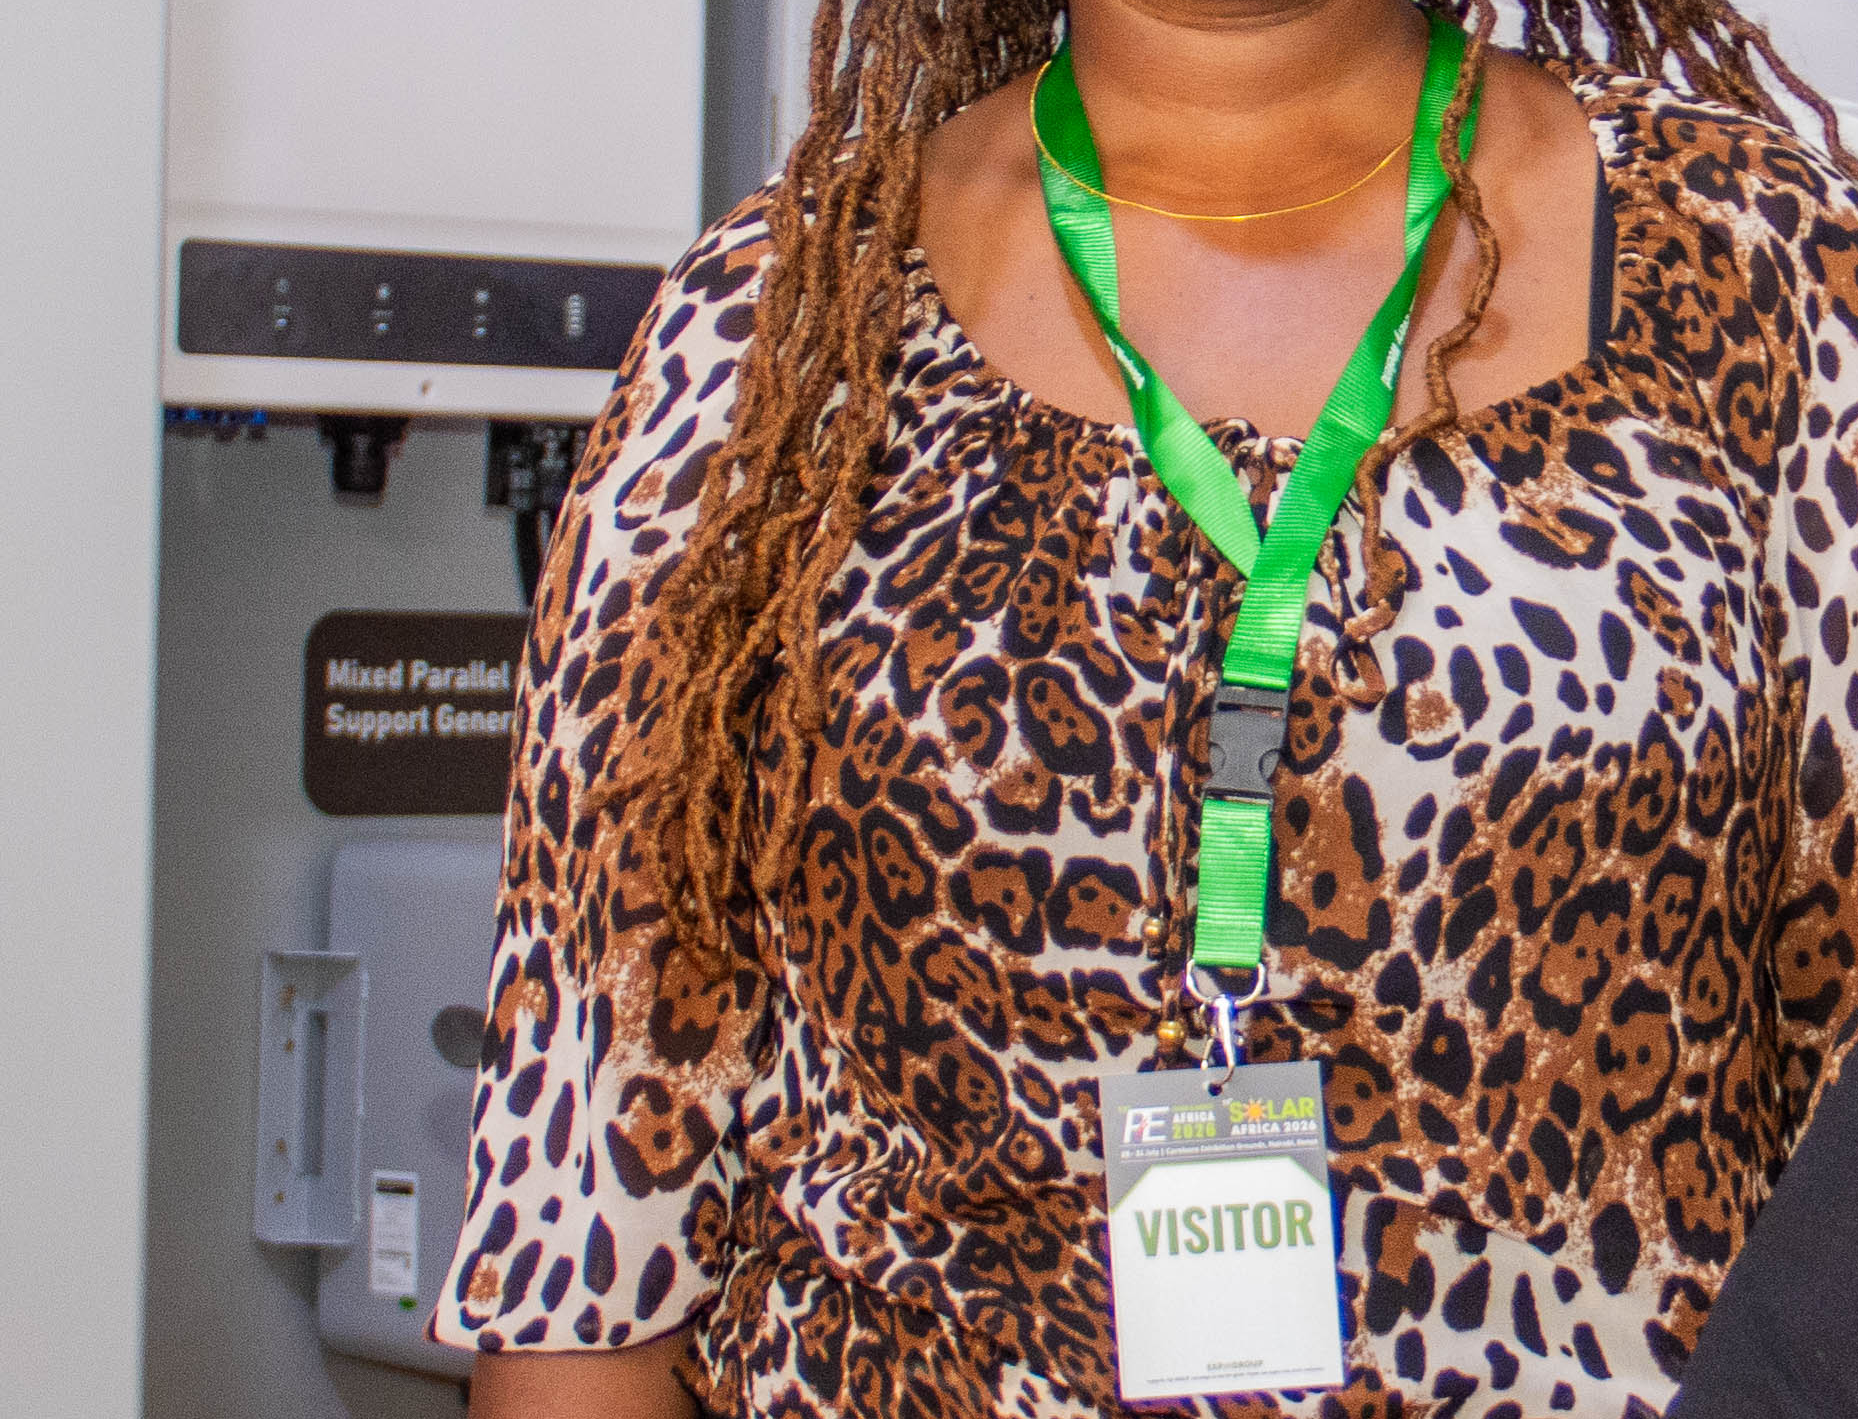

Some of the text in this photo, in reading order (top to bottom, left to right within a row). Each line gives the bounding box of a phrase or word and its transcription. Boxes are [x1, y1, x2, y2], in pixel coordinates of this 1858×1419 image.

[327, 658, 511, 692] Mixed Parallel
[326, 701, 430, 743] Support
[1231, 1121, 1280, 1136] AFRICA
[1135, 1199, 1315, 1257] VISITOR
